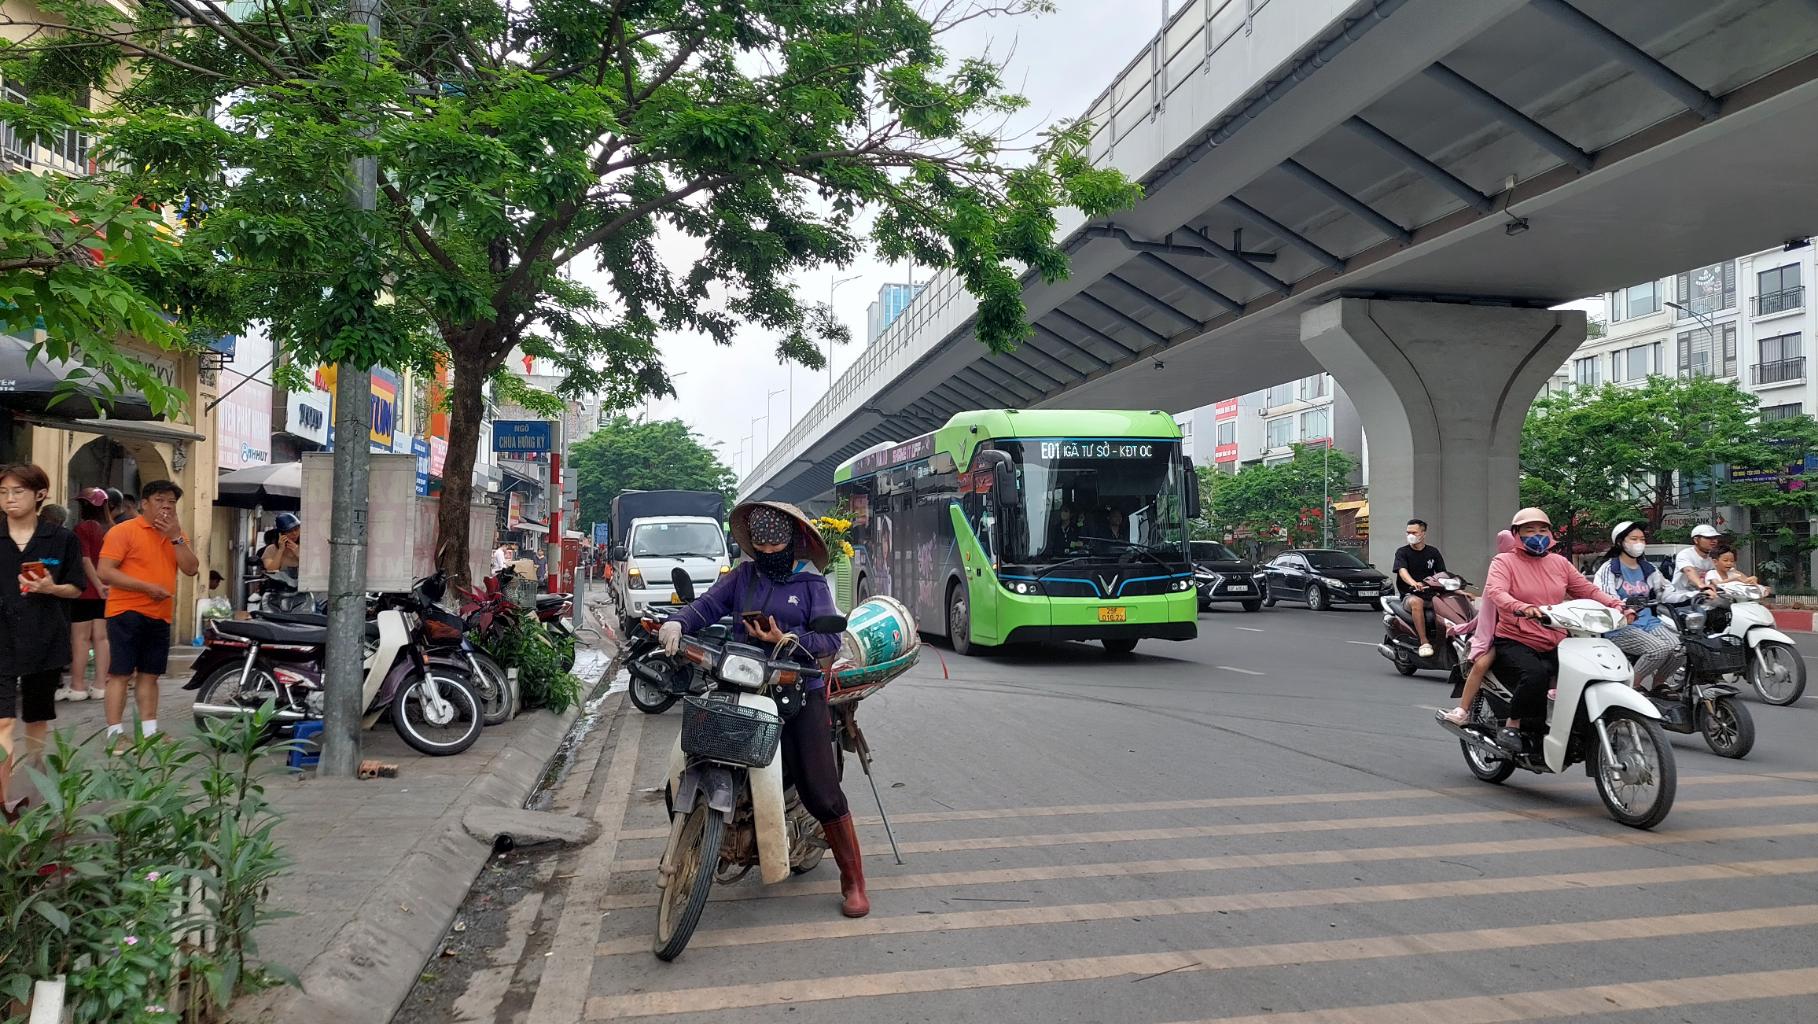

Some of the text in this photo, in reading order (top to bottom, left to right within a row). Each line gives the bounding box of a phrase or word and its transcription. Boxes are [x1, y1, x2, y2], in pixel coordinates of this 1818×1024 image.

[1041, 442, 1060, 459] E01
[1081, 443, 1094, 457] TƯ
[1096, 441, 1110, 457] SỞ
